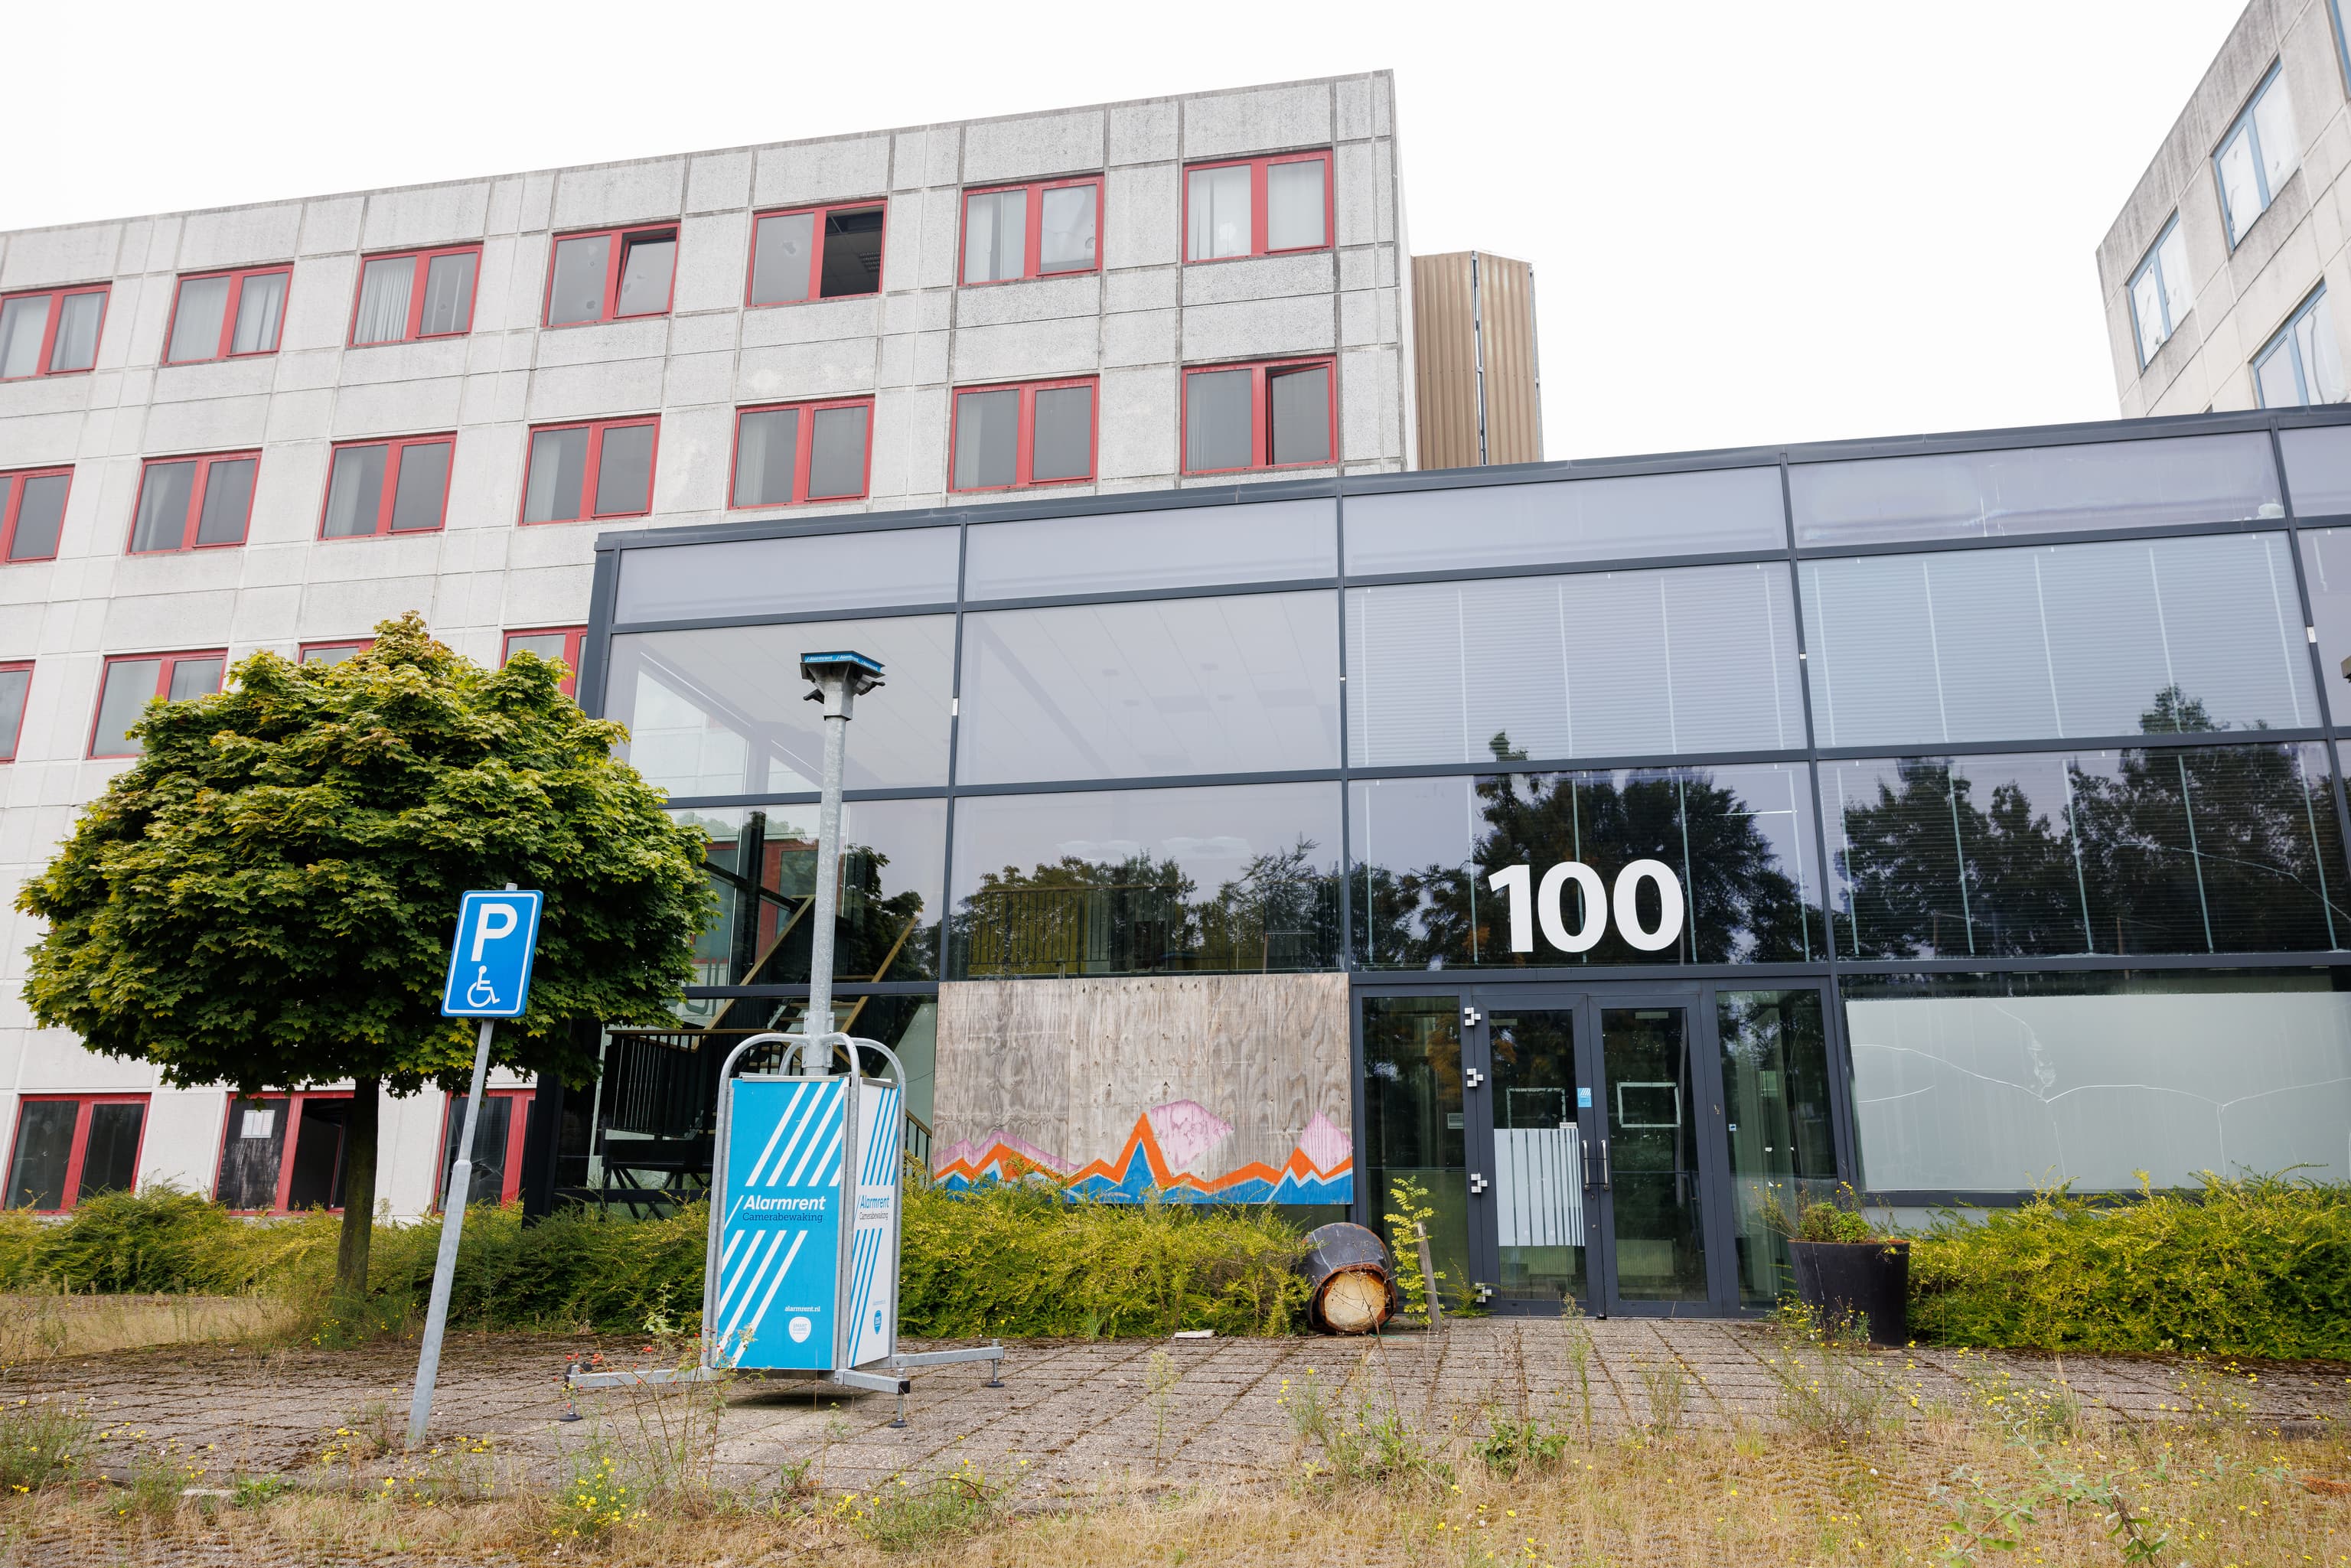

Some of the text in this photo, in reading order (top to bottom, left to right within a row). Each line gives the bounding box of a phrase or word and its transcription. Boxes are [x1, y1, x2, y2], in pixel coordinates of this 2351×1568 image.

[1489, 859, 1684, 953] 100
[471, 903, 518, 962] P
[744, 1195, 826, 1211] Alarmrent
[860, 1195, 889, 1208] Alarmrent
[742, 1213, 823, 1222] Camerabewaking
